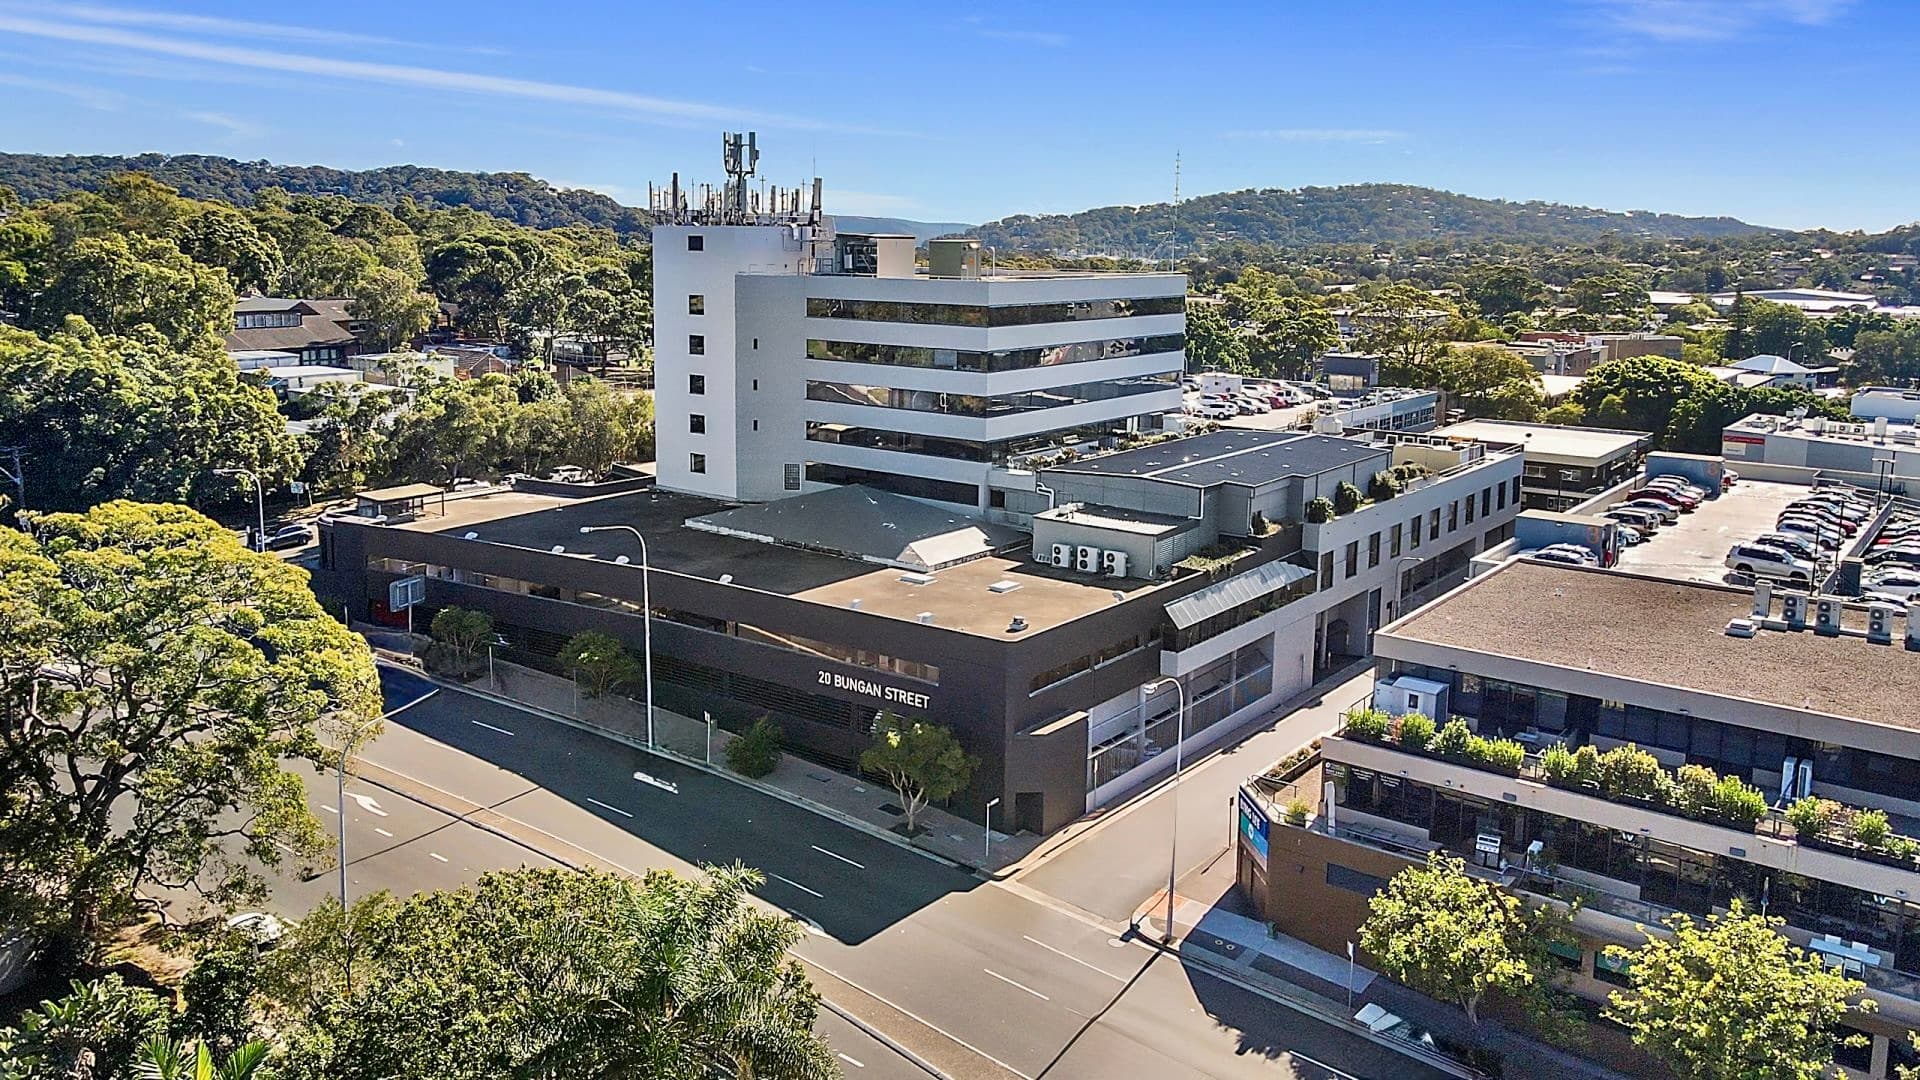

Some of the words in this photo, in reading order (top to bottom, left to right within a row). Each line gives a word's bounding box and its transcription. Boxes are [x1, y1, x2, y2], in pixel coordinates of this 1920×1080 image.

[818, 670, 831, 685] 20
[834, 674, 882, 698] BUNGAN
[884, 687, 930, 709] STREET
